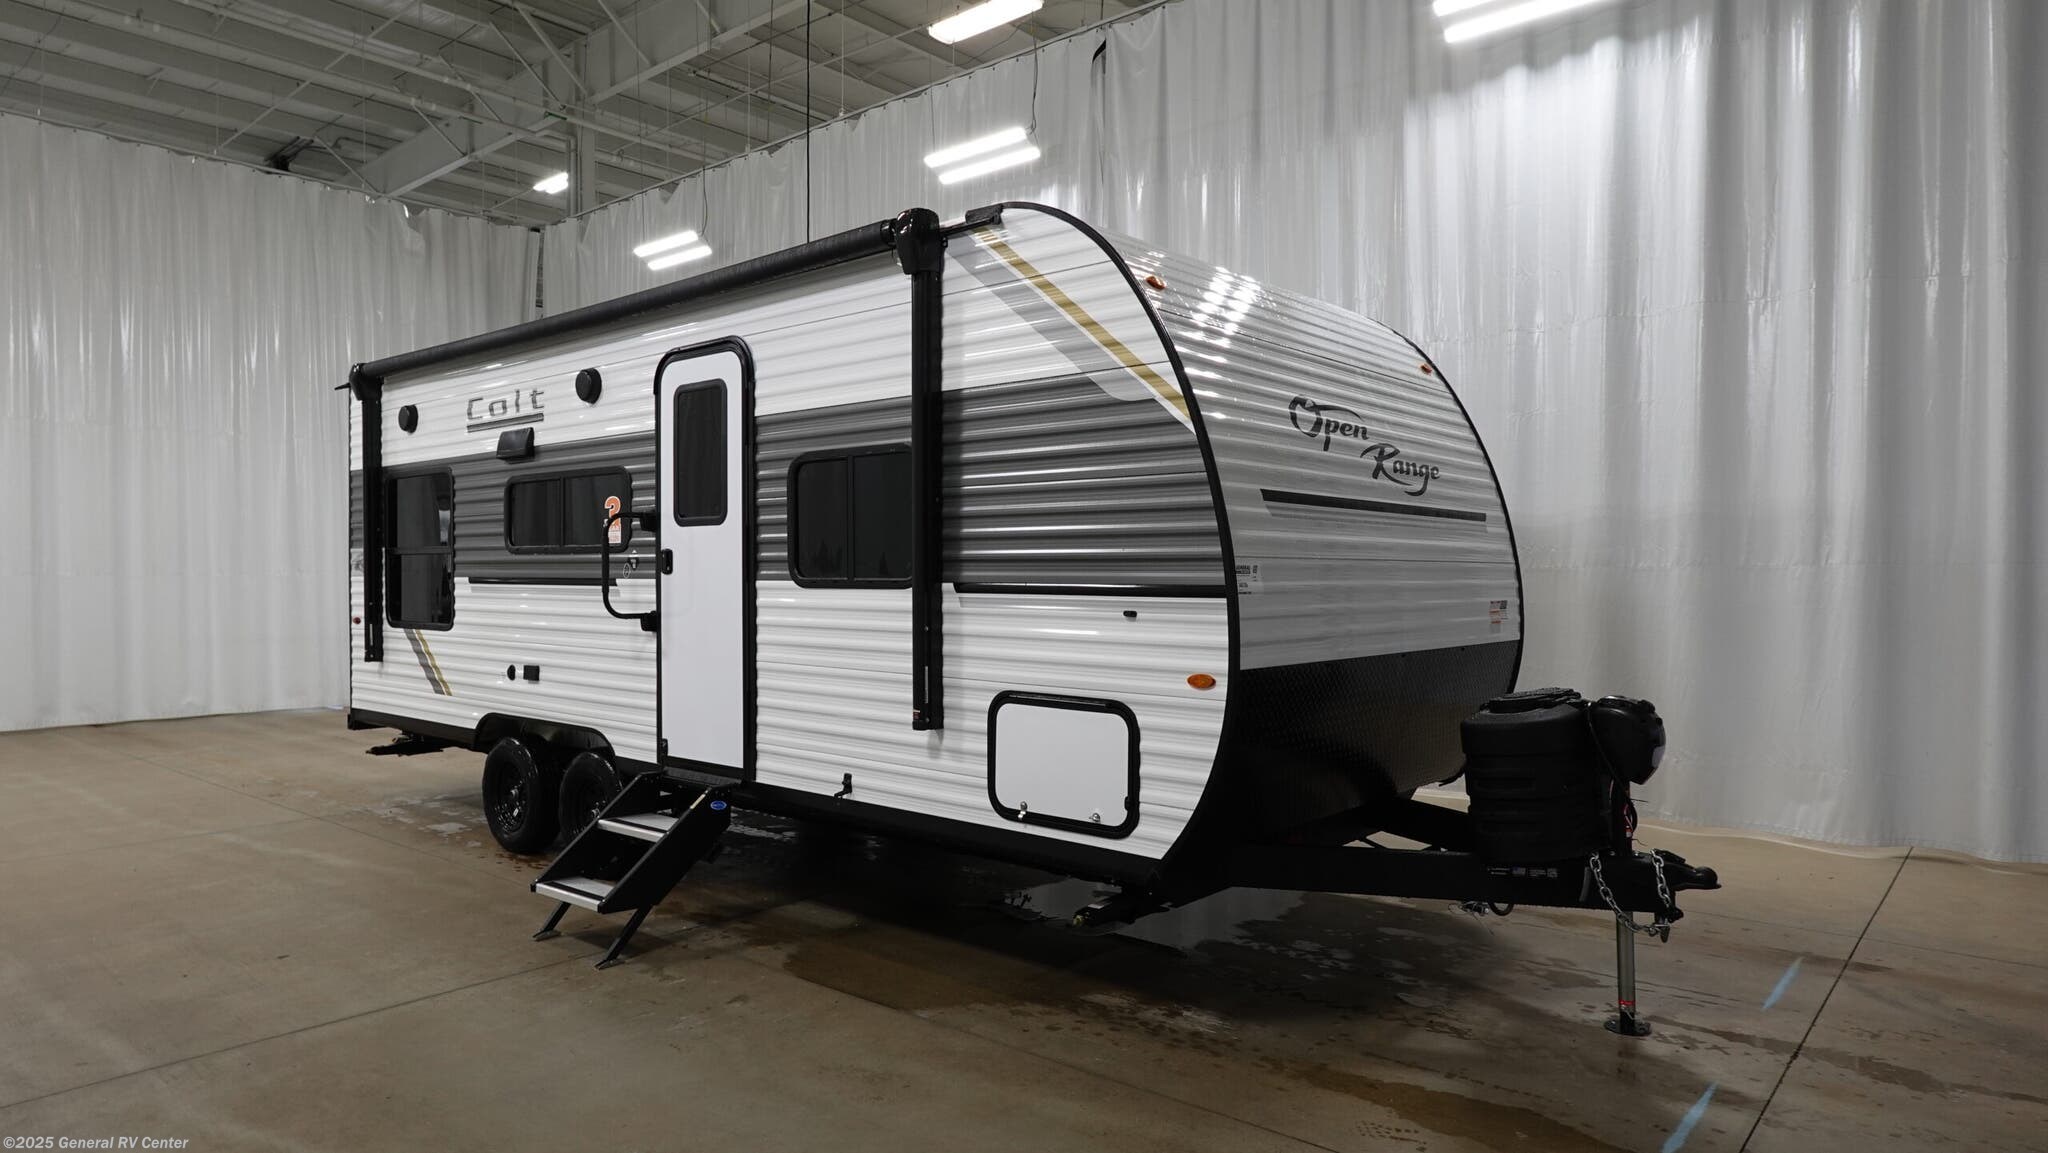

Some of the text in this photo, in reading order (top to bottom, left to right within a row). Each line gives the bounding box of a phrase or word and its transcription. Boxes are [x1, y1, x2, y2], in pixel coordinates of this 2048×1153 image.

[467, 389, 544, 420] Colt
[1288, 396, 1369, 452] Open
[1360, 443, 1440, 497] Range
